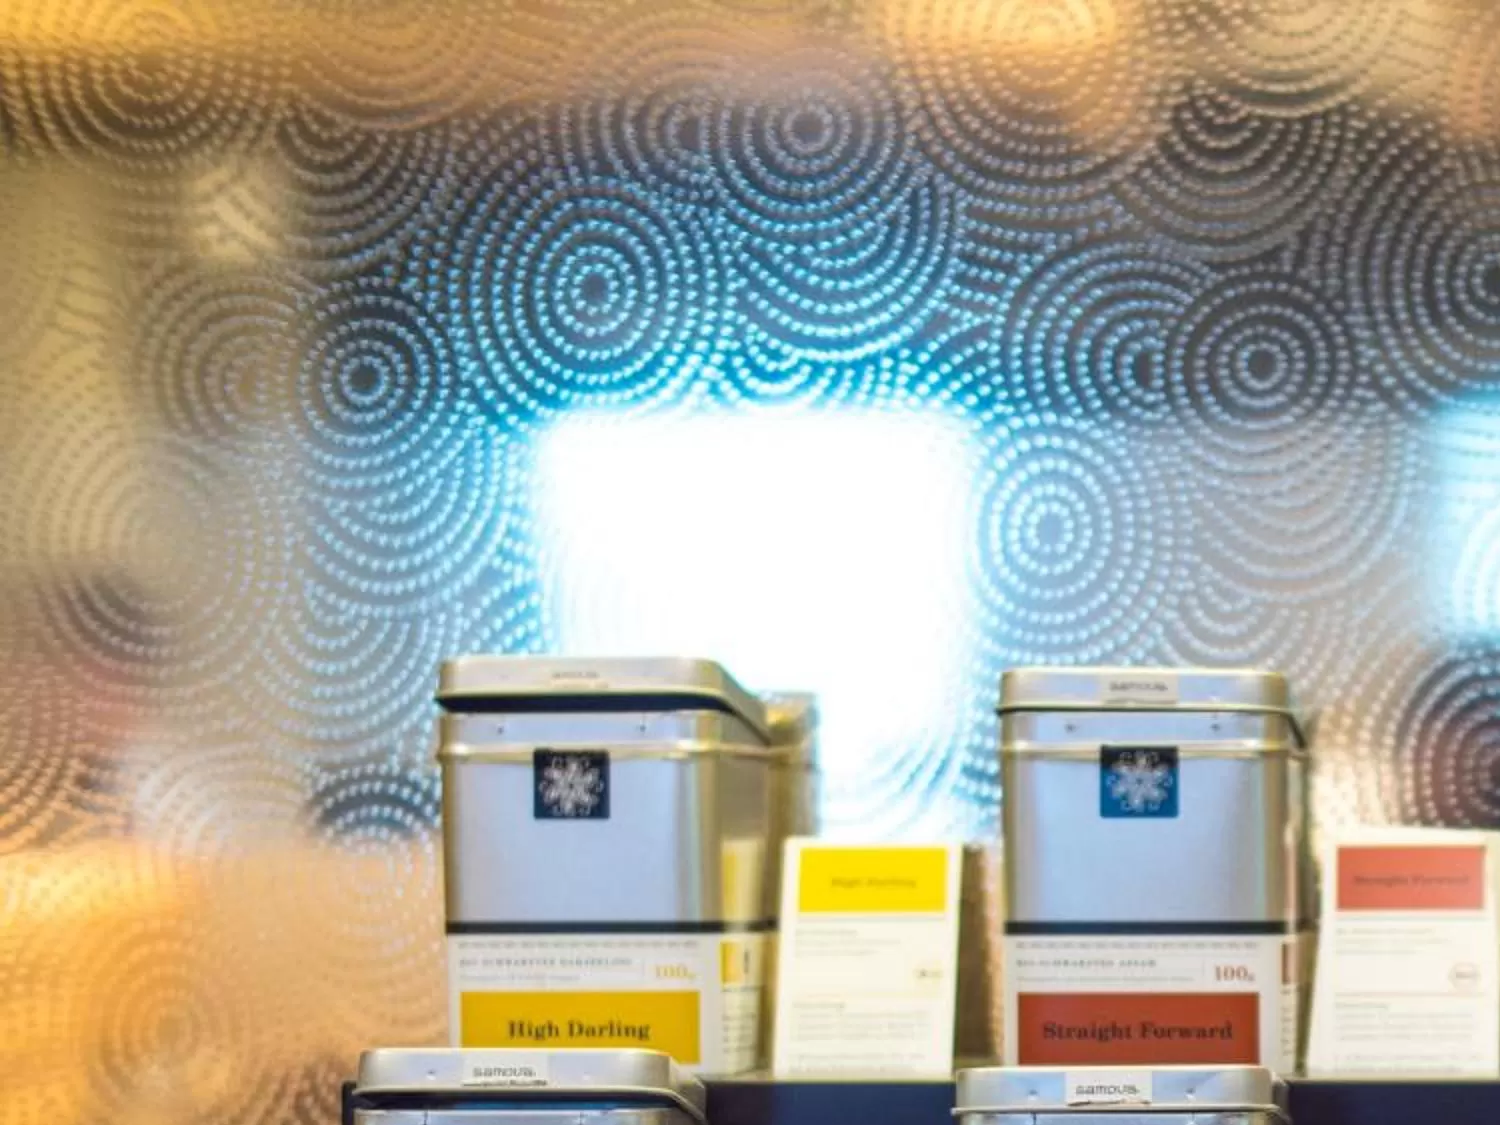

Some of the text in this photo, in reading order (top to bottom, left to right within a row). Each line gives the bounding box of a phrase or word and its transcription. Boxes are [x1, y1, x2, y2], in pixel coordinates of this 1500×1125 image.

[507, 1020, 651, 1041] High Darling
[1042, 1020, 1234, 1042] Straight Forward
